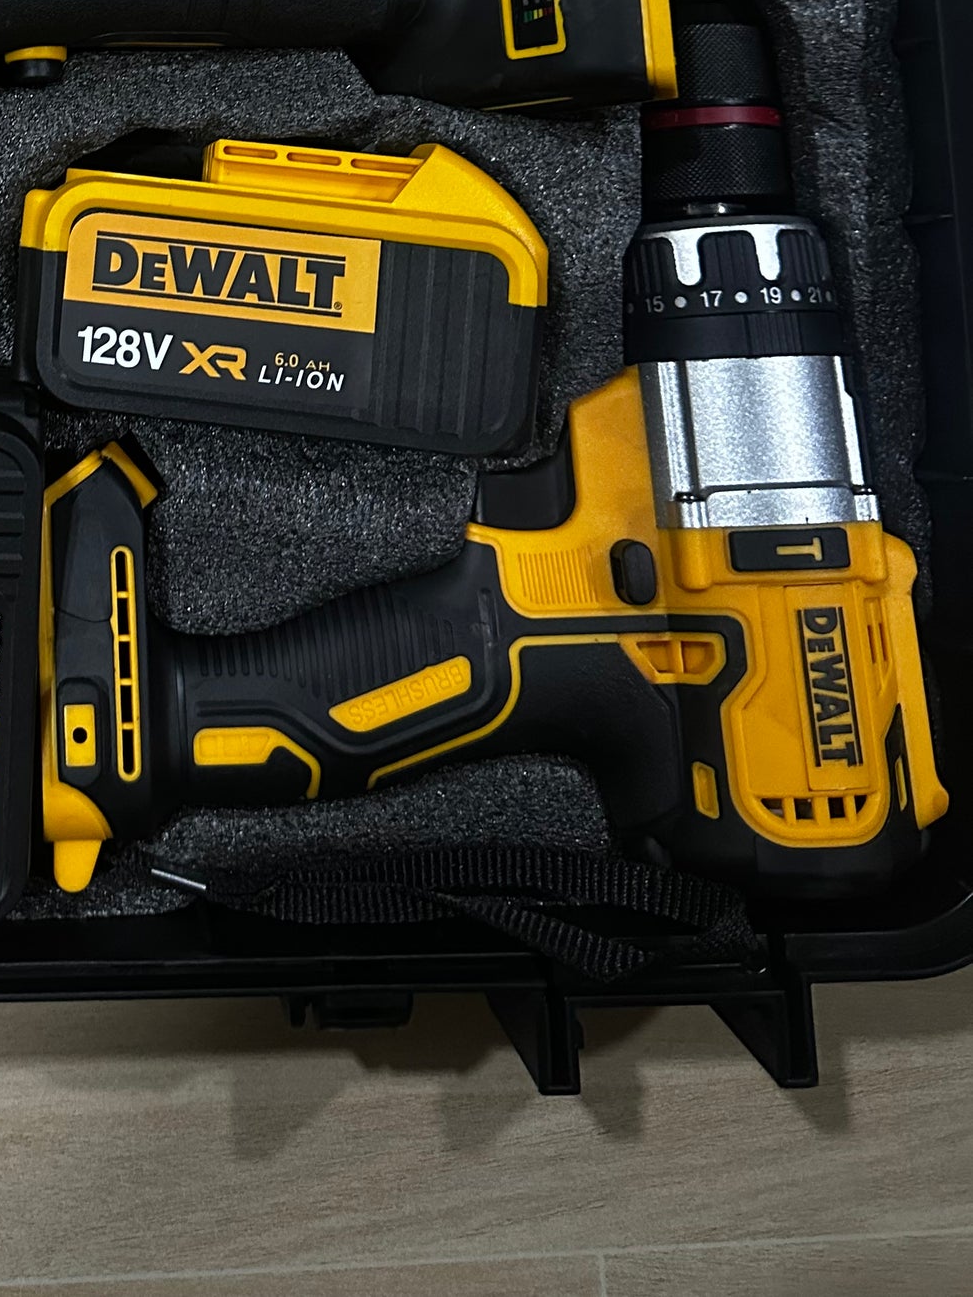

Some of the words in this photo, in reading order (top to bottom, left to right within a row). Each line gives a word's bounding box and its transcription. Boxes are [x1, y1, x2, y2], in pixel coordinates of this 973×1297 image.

[647, 296, 664, 313] 15
[700, 291, 723, 307] 17
[760, 287, 782, 304] 19
[78, 325, 174, 371] 128V
[179, 341, 246, 381] XR
[274, 352, 299, 369] 6.0
[306, 359, 330, 372] AH
[258, 365, 345, 392] LI-ION
[348, 663, 465, 725] BRUSHLESS
[804, 607, 857, 766] DEWALT
